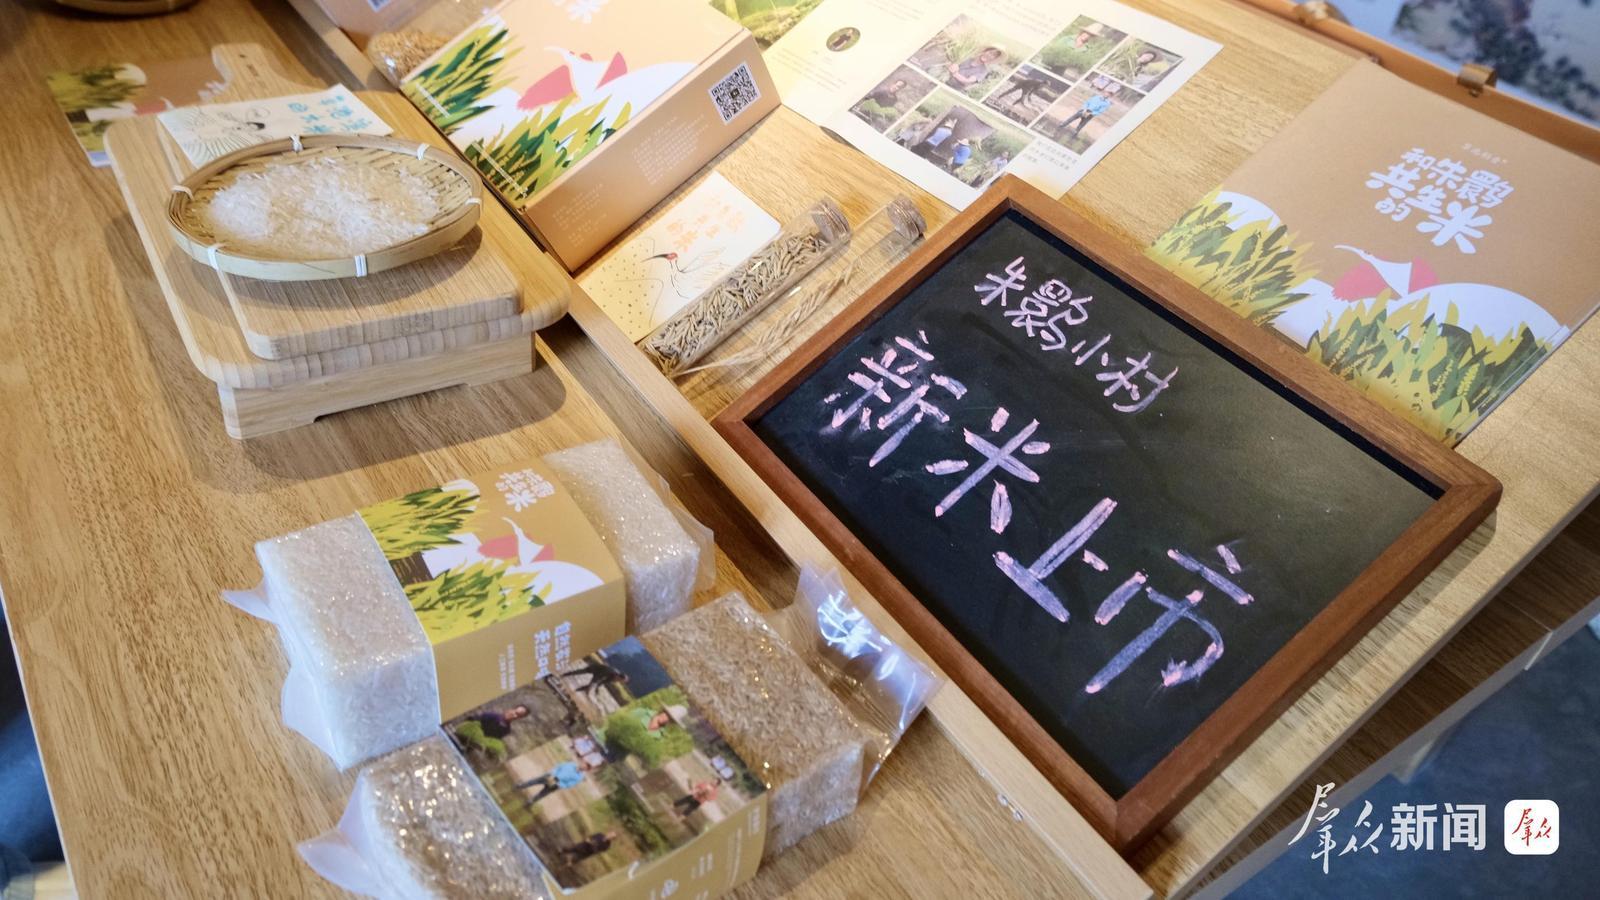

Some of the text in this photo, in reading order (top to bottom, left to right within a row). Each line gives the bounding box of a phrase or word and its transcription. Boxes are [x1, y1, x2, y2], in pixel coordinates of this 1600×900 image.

[1400, 147, 1514, 208] 和朱鹮
[973, 256, 1180, 413] 朱鹮小村
[823, 329, 1255, 695] 新米上市
